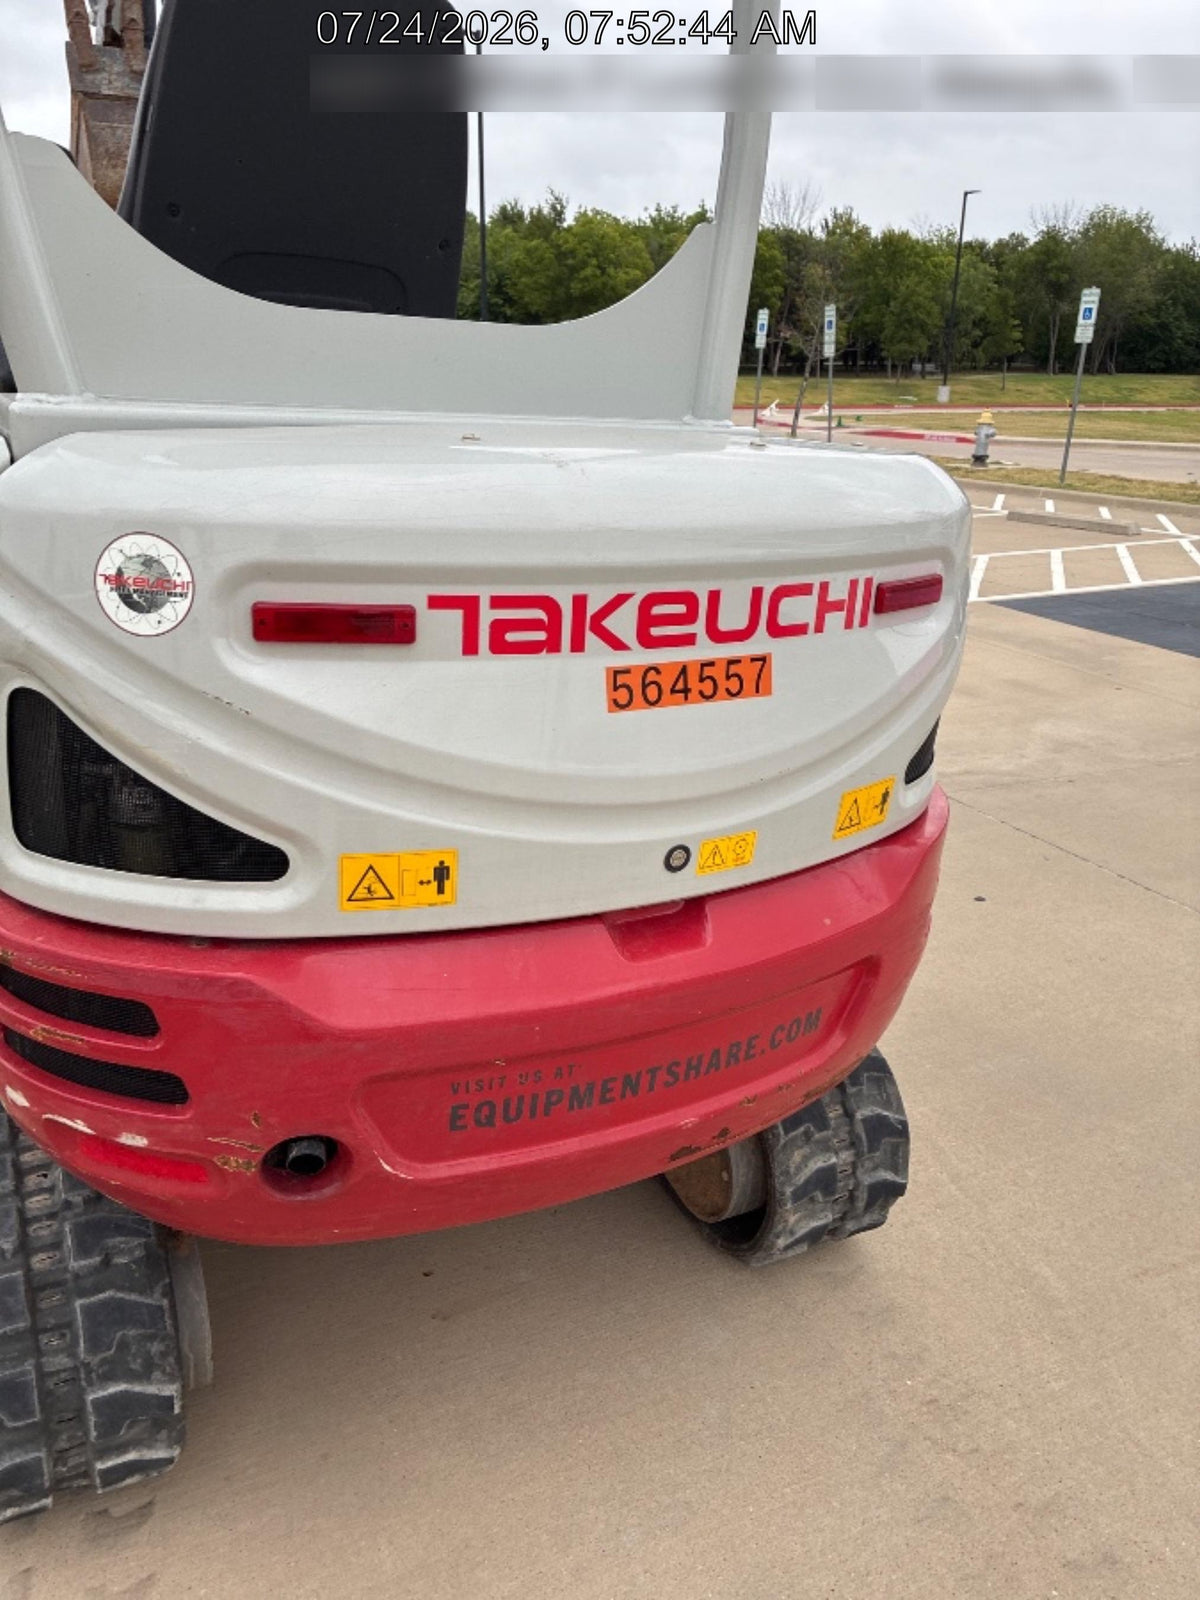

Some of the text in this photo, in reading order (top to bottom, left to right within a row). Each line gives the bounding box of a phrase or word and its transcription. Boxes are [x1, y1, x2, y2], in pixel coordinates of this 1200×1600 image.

[610, 656, 768, 708] 564557
[448, 1007, 823, 1132] EQUIPMENTSHARE.COM
[451, 1075, 506, 1095] VISIT
[518, 1069, 543, 1085] US
